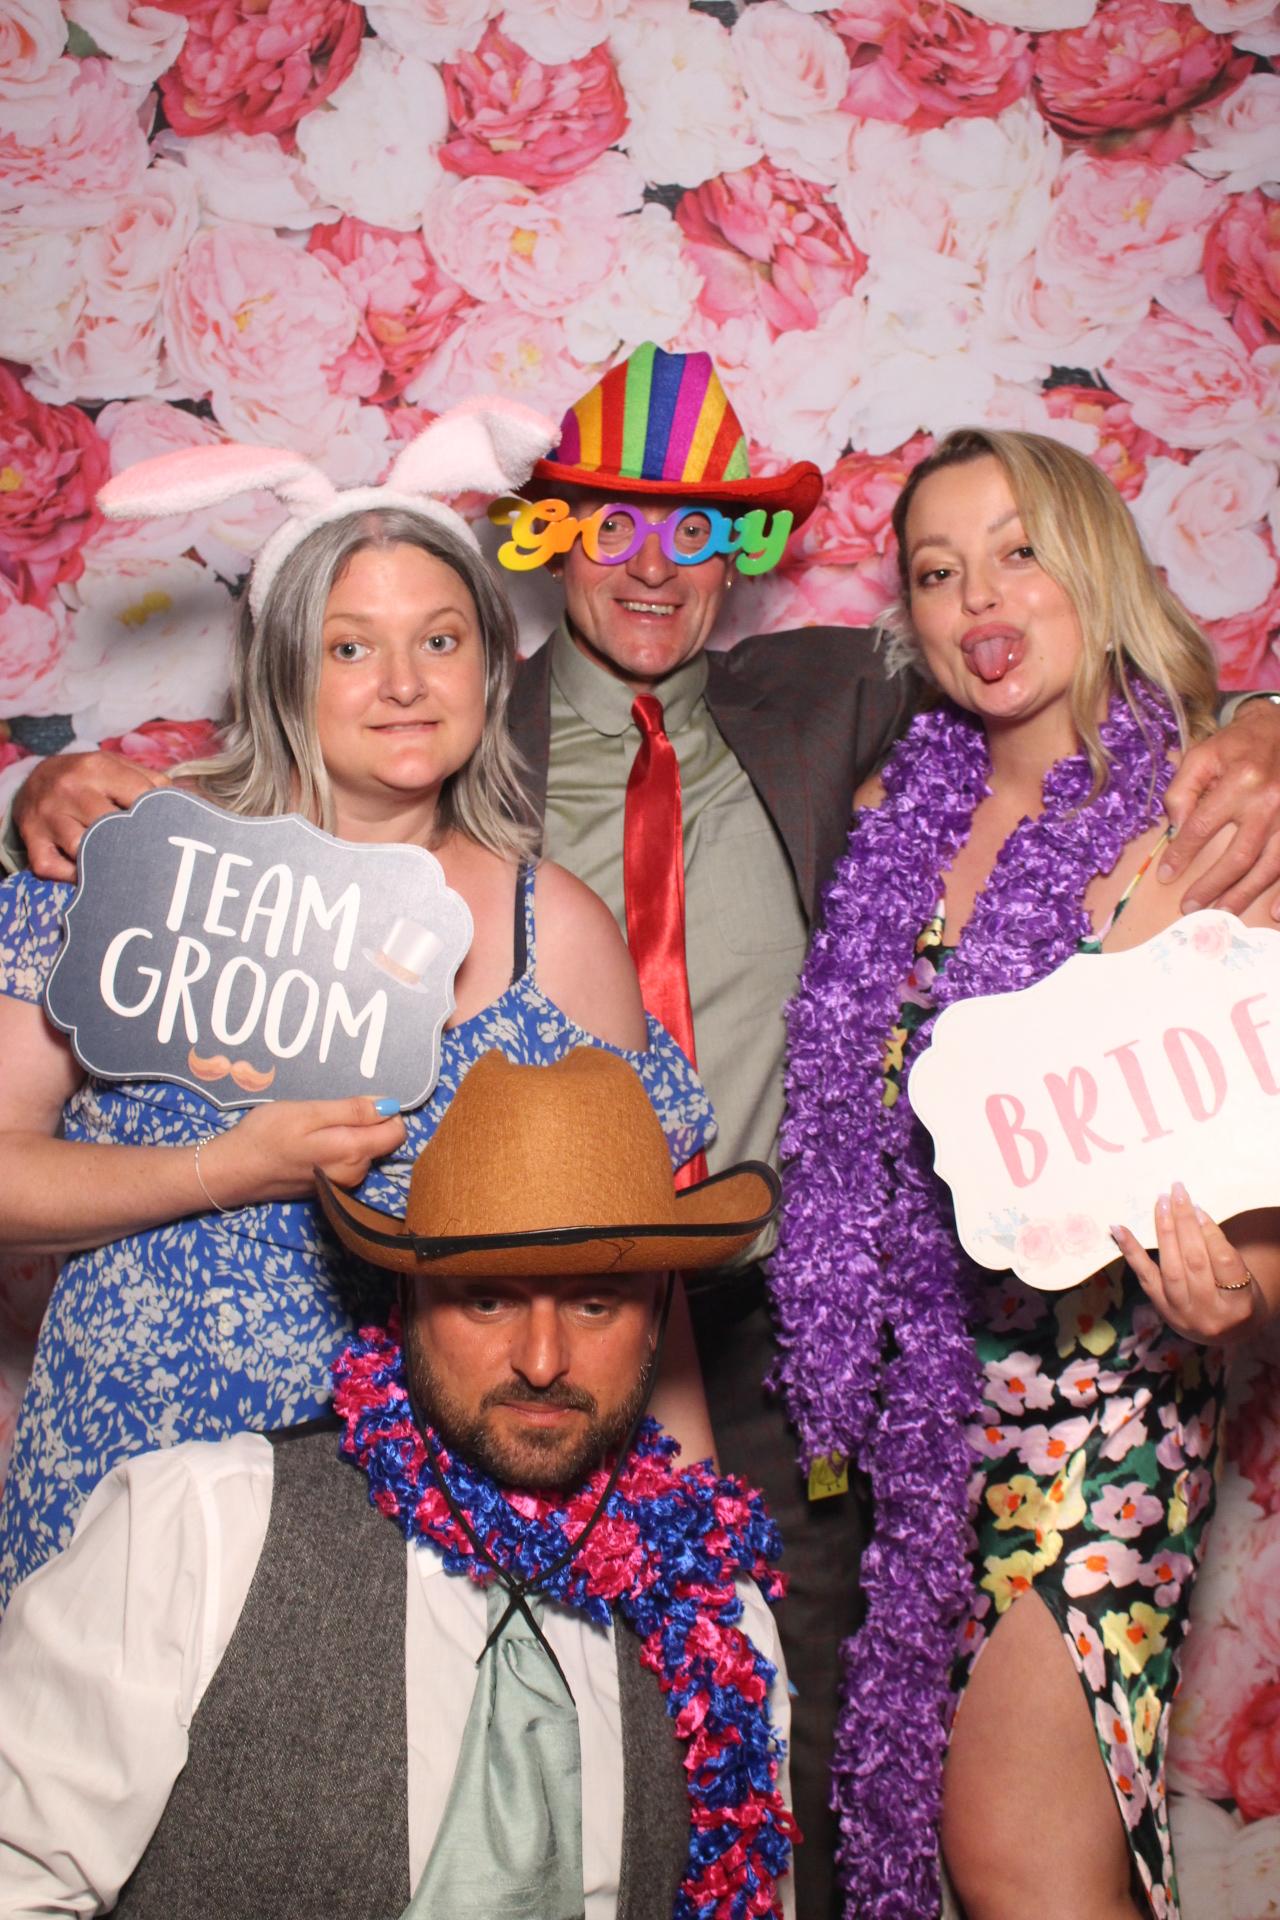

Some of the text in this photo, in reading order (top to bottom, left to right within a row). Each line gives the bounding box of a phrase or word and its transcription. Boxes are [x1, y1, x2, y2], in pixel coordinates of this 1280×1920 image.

[166, 836, 361, 971] TEAM
[100, 928, 388, 1079] GROOM
[985, 992, 1280, 1189] BRIDE
